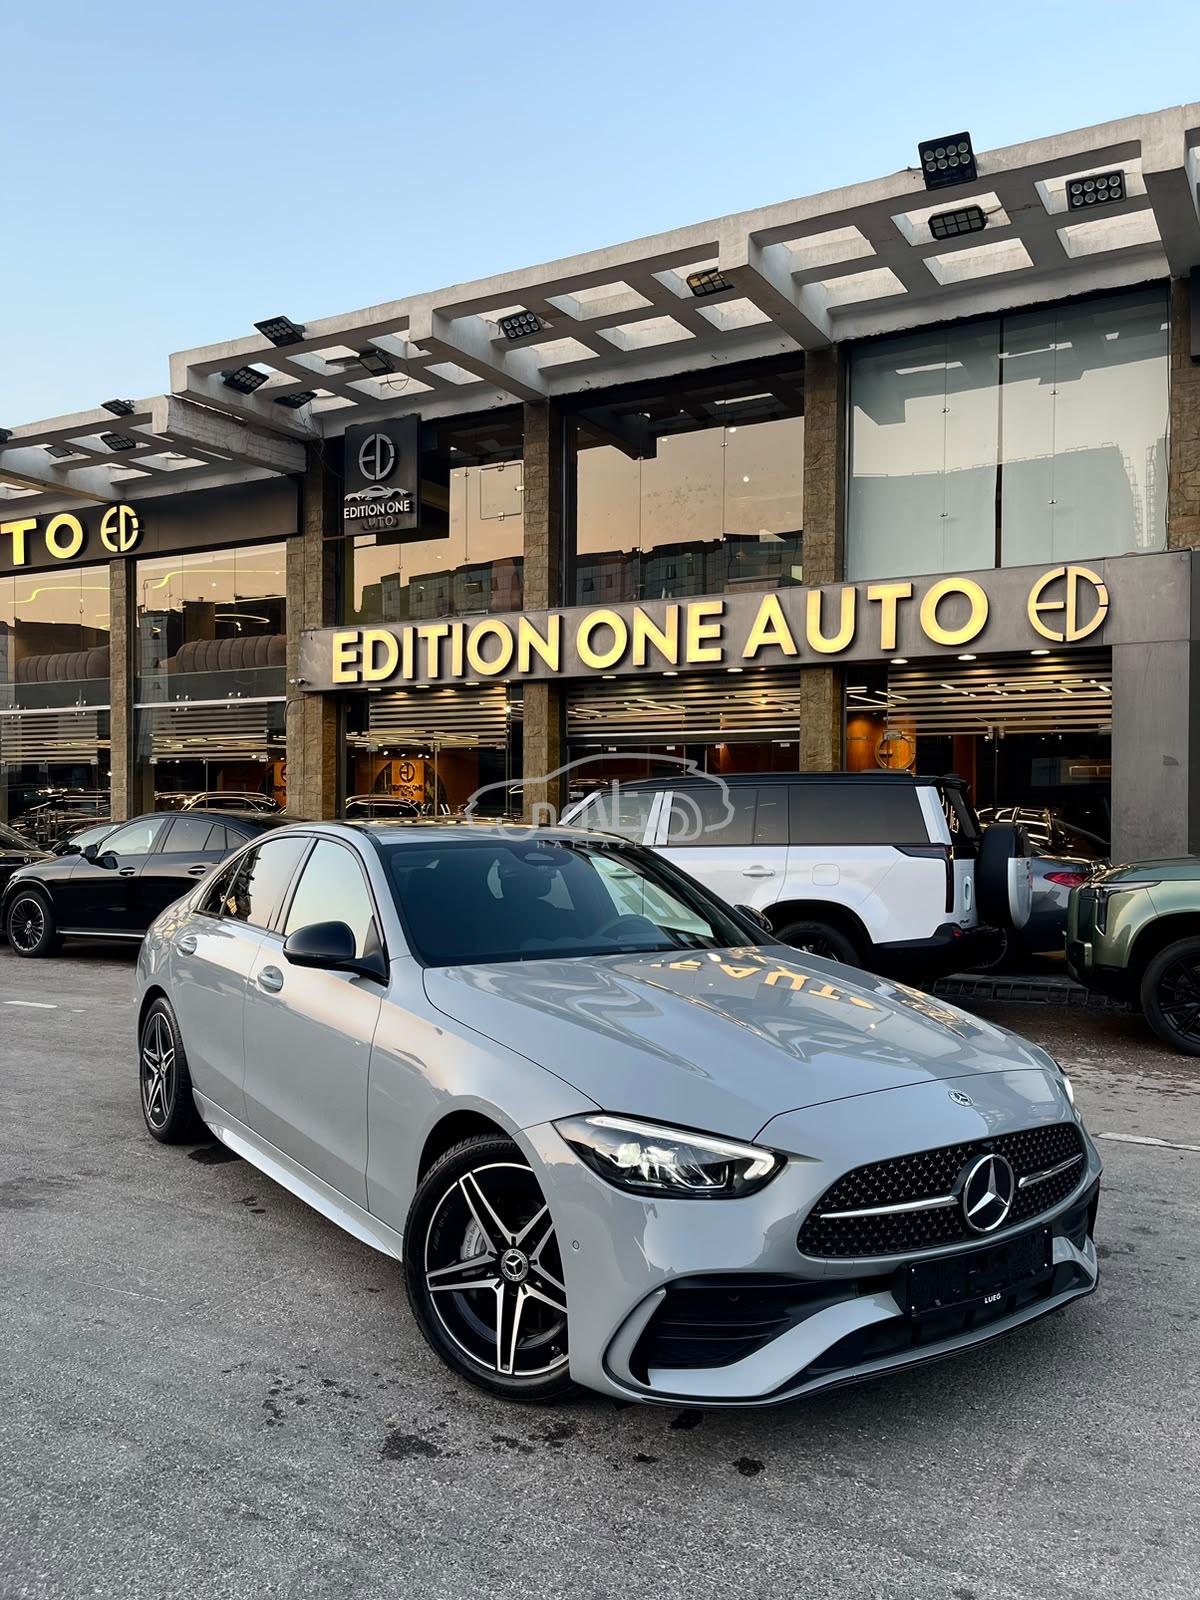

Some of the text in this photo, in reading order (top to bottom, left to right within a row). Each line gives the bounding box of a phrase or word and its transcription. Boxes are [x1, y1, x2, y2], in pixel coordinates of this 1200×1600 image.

[344, 500, 410, 519] EDITION ONE
[0, 513, 84, 566] TO
[331, 614, 562, 683] EDITION
[576, 601, 724, 669] ONE
[742, 577, 989, 658] AUTO
[984, 1292, 1002, 1304] LUEG
